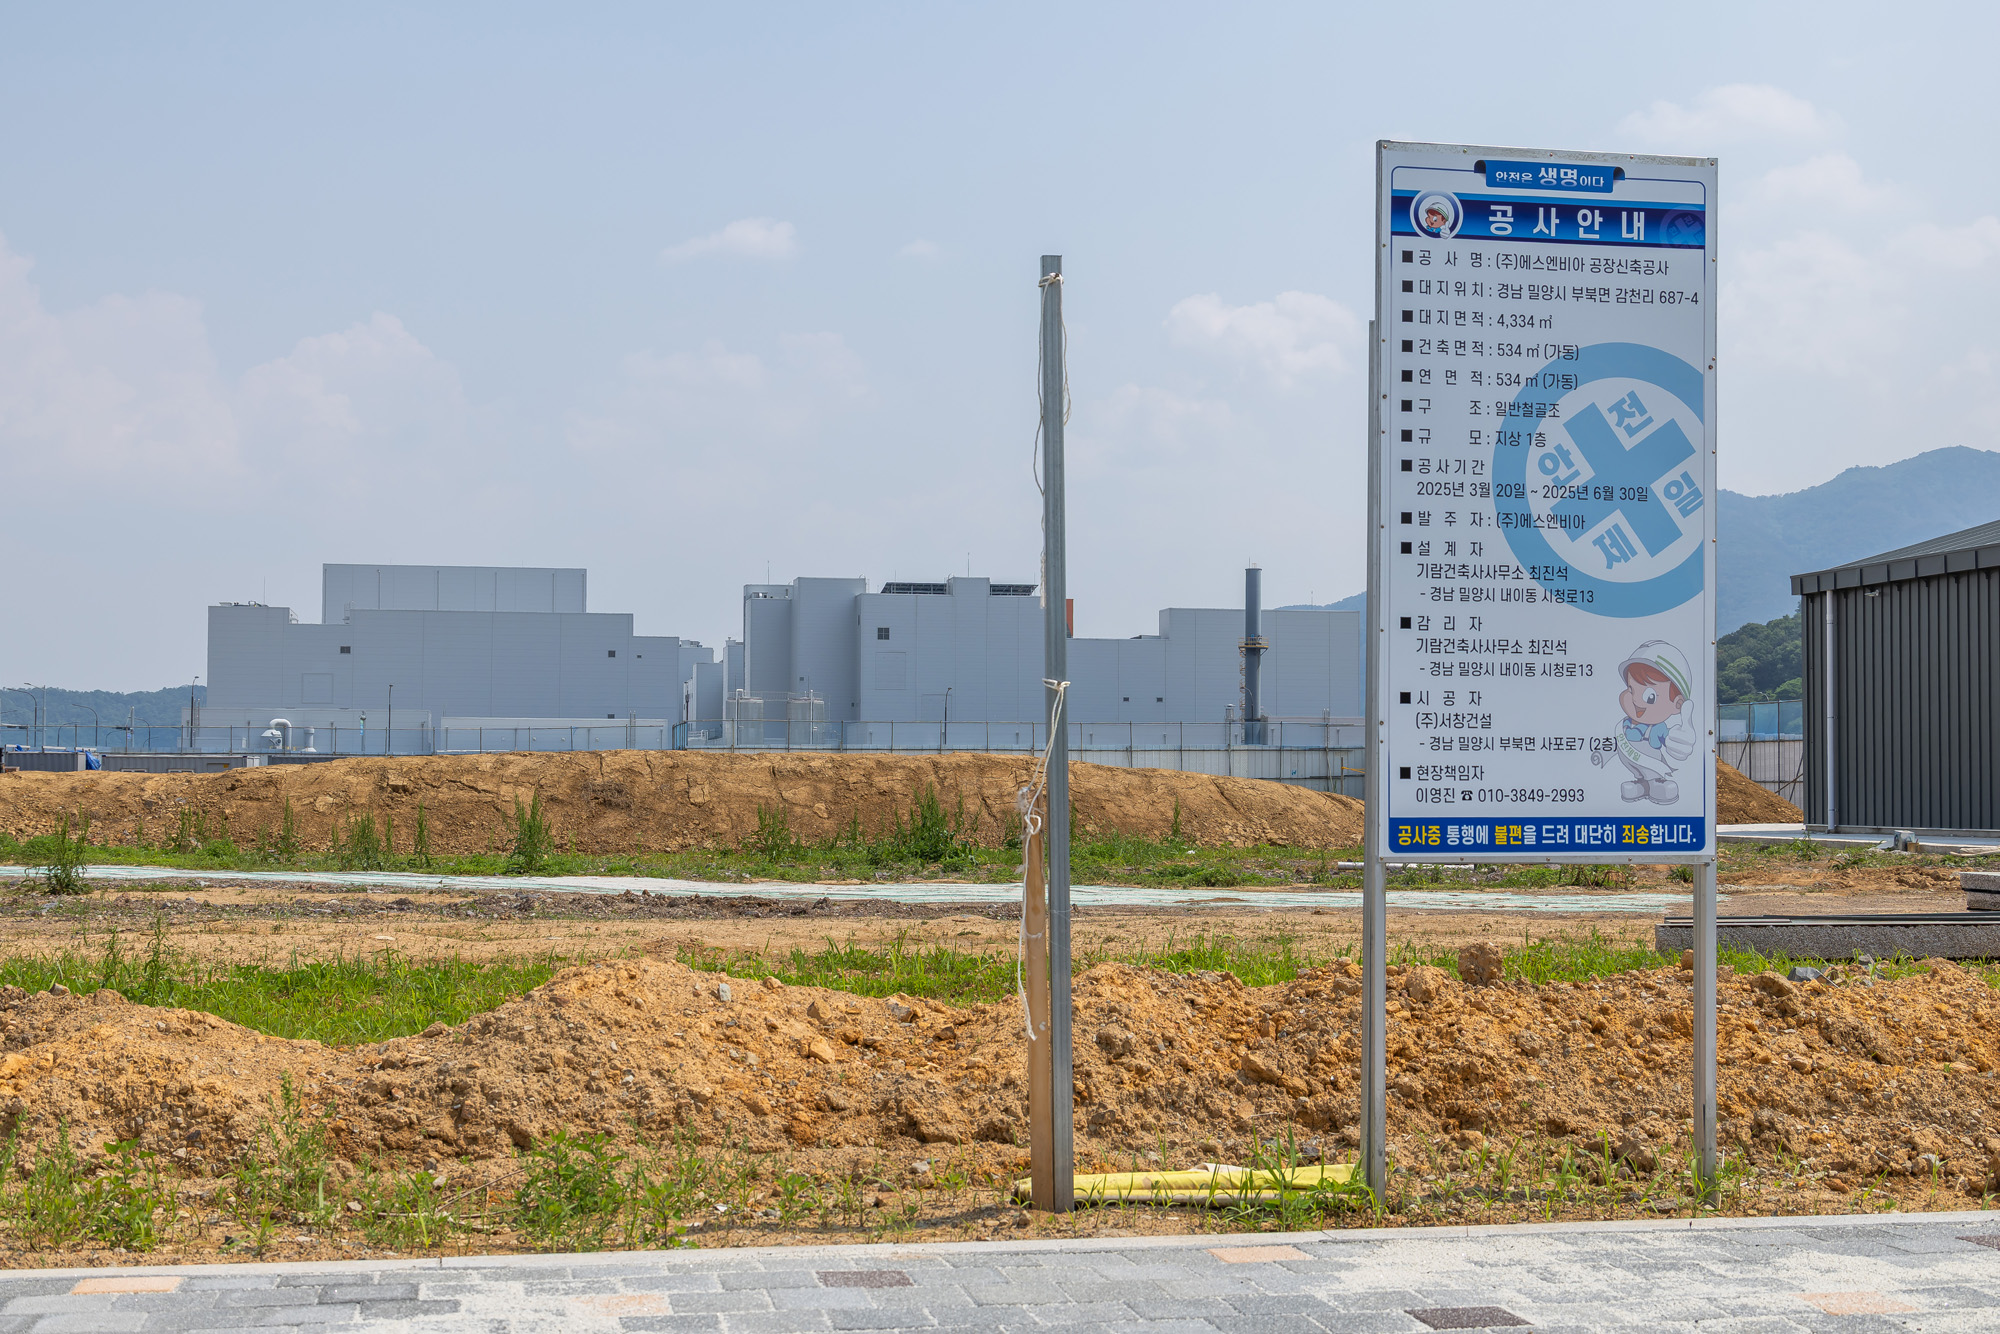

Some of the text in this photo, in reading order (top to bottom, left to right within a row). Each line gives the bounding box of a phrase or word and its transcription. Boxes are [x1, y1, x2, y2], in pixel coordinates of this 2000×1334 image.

[1496, 168, 1604, 186] 안전은 생명이다
[1497, 253, 1585, 271] (주)에스엔비아
[1590, 258, 1668, 275] 공장신축공사
[1498, 284, 1523, 299] 경남
[1529, 285, 1565, 300] 밀양시
[1572, 287, 1609, 302] 부북면
[1616, 289, 1653, 304] 감천리
[1660, 291, 1698, 304] 687-4
[1497, 314, 1534, 328] 4,334
[1498, 344, 1522, 356] 534
[1545, 344, 1578, 360] (가동)
[1497, 373, 1520, 386] 534
[1544, 374, 1577, 390] (가동)
[1496, 402, 1559, 417] 일반철골조
[1496, 431, 1521, 446] 지상
[1527, 432, 1546, 447] 1층
[1417, 482, 1463, 497] 2025년
[1470, 482, 1489, 497] 3월
[1497, 483, 1524, 498] 20일
[1543, 485, 1588, 500] 2025년
[1594, 486, 1613, 500] 6월
[1620, 487, 1647, 501] 30일
[1497, 512, 1585, 529] (주)에스엔비아
[1418, 564, 1567, 581] 기람건축사사무소 최진석
[1431, 587, 1454, 601] 경남
[1460, 588, 1494, 602] 밀양시
[1501, 588, 1536, 603] 내이동
[1542, 589, 1593, 603] 시청로13
[1417, 639, 1566, 655] 기람건축사사무소 최진석
[1430, 662, 1454, 676] 경남
[1459, 662, 1494, 676] 밀양시
[1501, 663, 1535, 677] 내이동
[1541, 663, 1592, 677] 시청로13
[1416, 712, 1491, 729] (주)서창건설
[1430, 737, 1453, 750] 경남
[1459, 737, 1493, 751] 밀양시
[1500, 737, 1535, 750] 부북면
[1541, 737, 1584, 750] 사포로7
[1590, 737, 1617, 752] (2층)
[1417, 765, 1484, 781] 현장책임자
[1417, 788, 1584, 803] 이영진 010-3849-2993
[1399, 824, 1696, 845] 공사중 통행에 불편을 드려 대단히 죄송합니다.
